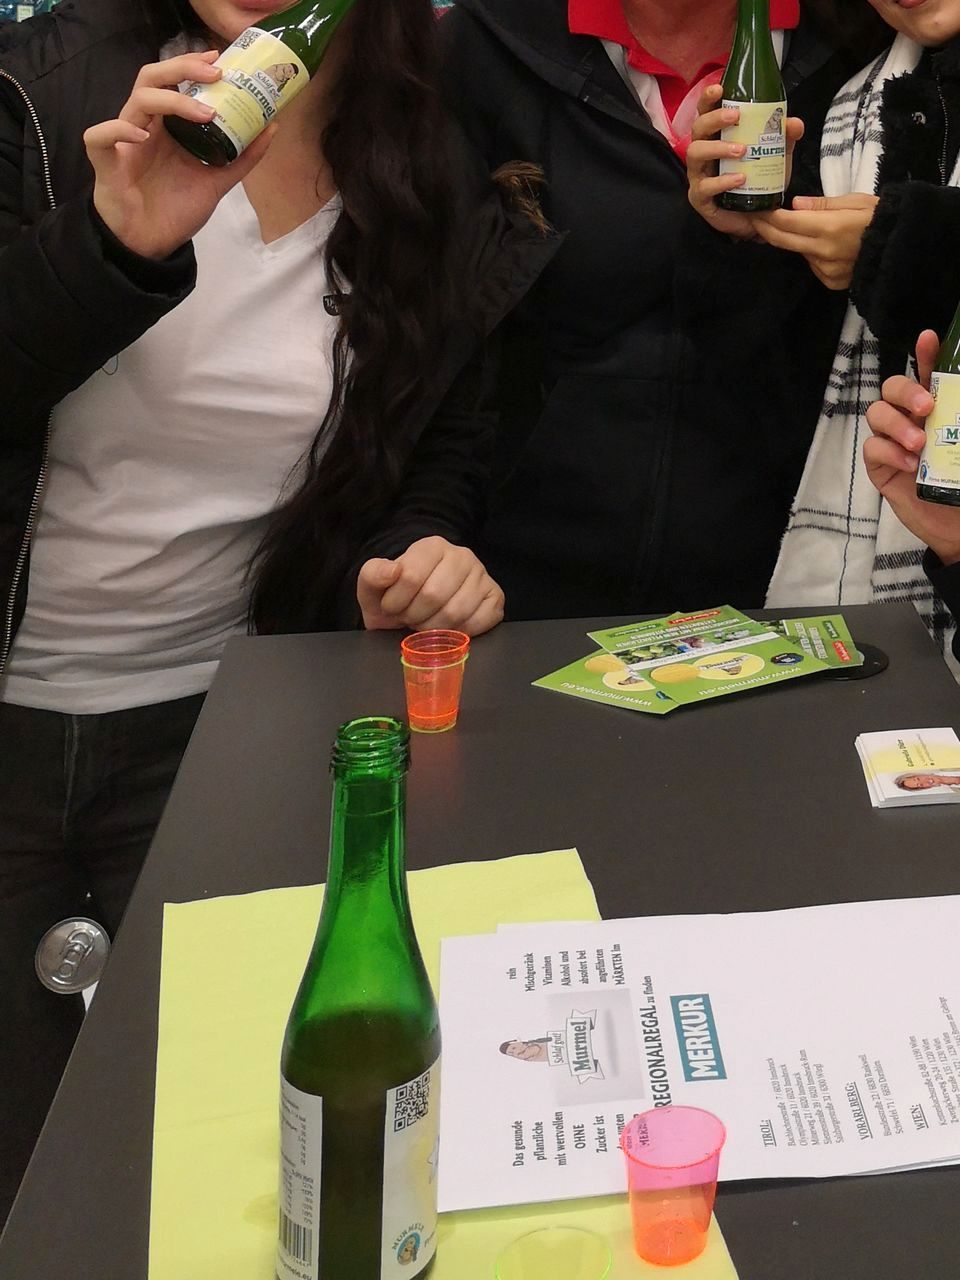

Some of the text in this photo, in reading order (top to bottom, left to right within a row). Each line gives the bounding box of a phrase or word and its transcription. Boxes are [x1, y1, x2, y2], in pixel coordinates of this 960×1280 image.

[235, 73, 276, 117] Murmel
[698, 666, 801, 695] www.murmele.eu
[506, 968, 516, 980] rein
[524, 953, 536, 992] Mischgetränk
[542, 956, 552, 986] Vitaminen
[559, 951, 571, 986] Alkohol und
[576, 950, 589, 984] absofort bei
[595, 949, 608, 982] angeführten
[611, 944, 625, 985] MÄRKTEN im
[642, 976, 653, 994] finden
[570, 1021, 591, 1072] Murmel
[679, 997, 719, 1078] MERKUR
[909, 1036, 918, 1048] Wien
[922, 1038, 930, 1050] Wien
[933, 1038, 942, 1050] Wien
[943, 1032, 951, 1044] Wien
[640, 1005, 673, 1108] REGIONALREGAL
[766, 1058, 778, 1080] Innsbruck
[778, 1064, 792, 1086] Innsbruck
[792, 1072, 806, 1095] Innsbruck
[948, 1076, 960, 1092] Straße
[845, 1083, 869, 1140] VORARLBERG:
[910, 1105, 925, 1130] WIEN:
[512, 1121, 526, 1166] Das gesunde
[532, 1122, 546, 1160] pflanzliche
[552, 1112, 566, 1165] mit wertvollen
[573, 1124, 586, 1149] OHNE
[593, 1116, 607, 1153] Zucker ist
[760, 1120, 774, 1146] TIROL:
